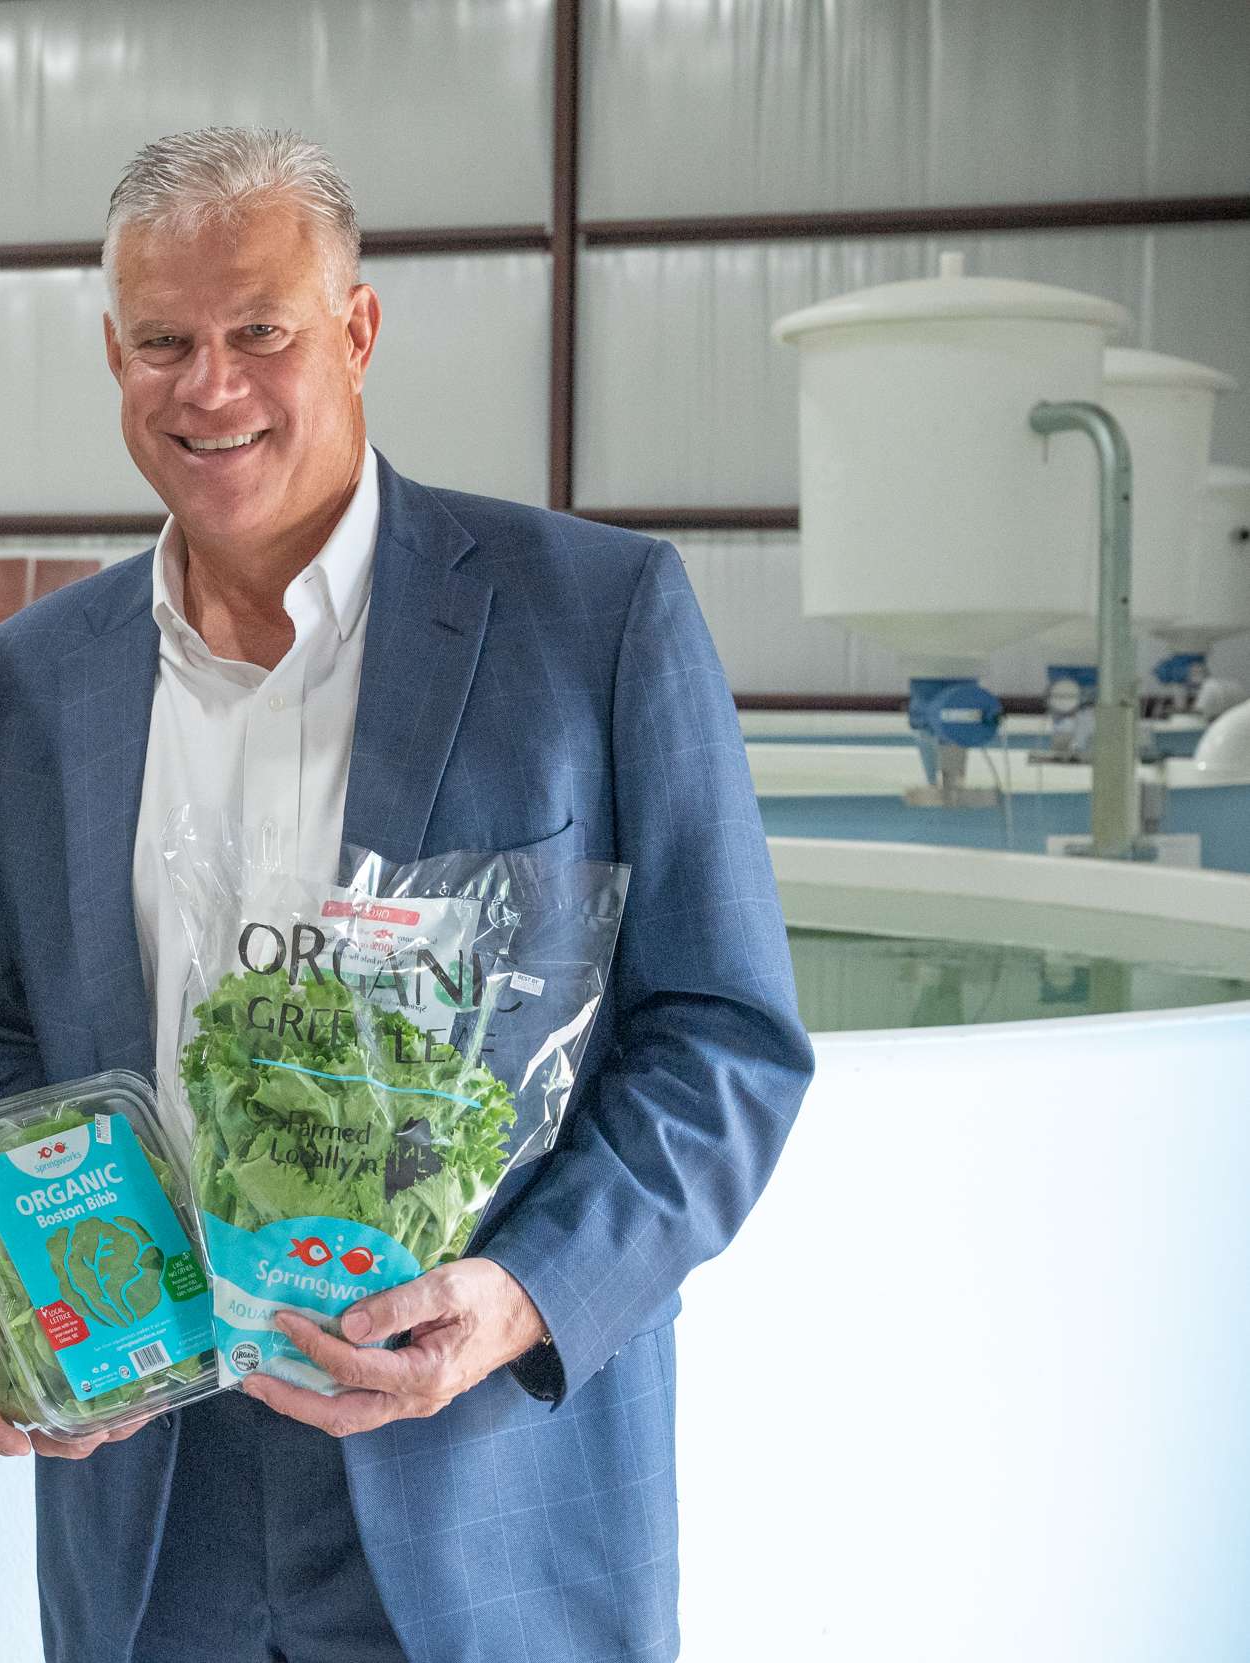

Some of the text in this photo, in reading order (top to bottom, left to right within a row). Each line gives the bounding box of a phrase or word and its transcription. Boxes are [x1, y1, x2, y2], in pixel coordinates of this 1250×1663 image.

[247, 996, 362, 1048] GREE
[288, 1111, 371, 1145] Farmed
[15, 1163, 124, 1216] ORGANIC
[36, 1190, 118, 1229] Boston Bibb
[256, 1259, 390, 1301] Springwo
[50, 1311, 71, 1325] LETTUCE
